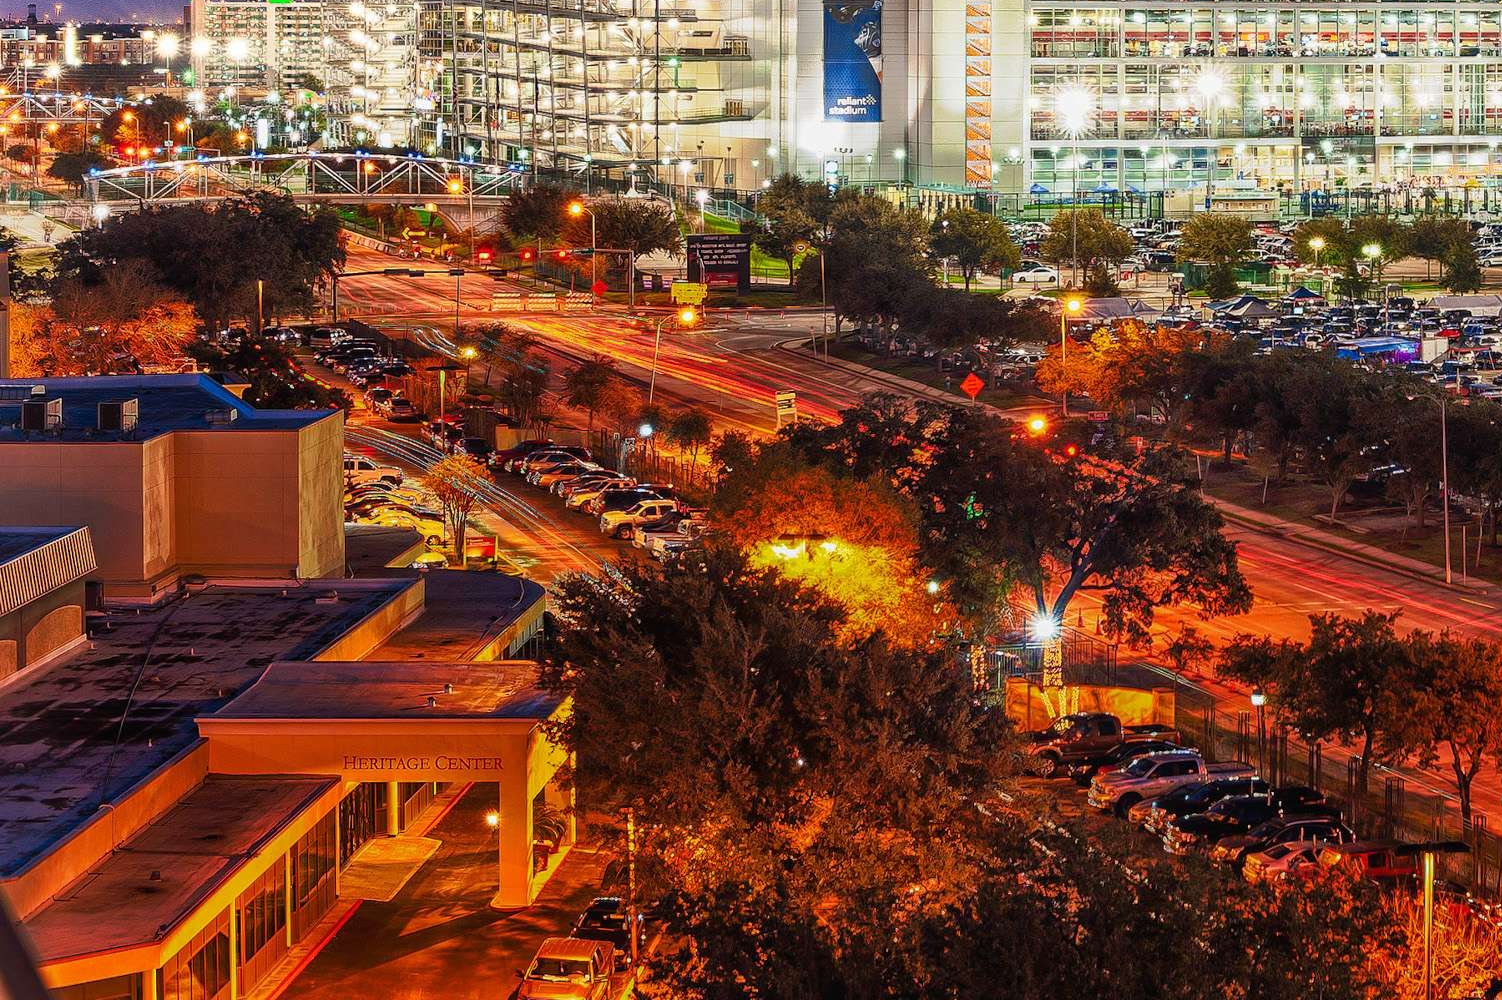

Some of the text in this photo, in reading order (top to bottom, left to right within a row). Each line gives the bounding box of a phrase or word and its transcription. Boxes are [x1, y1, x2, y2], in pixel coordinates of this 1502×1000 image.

[837, 96, 866, 106] reliant
[829, 105, 867, 115] stadium
[343, 755, 504, 770] HERITAGE CENTER
